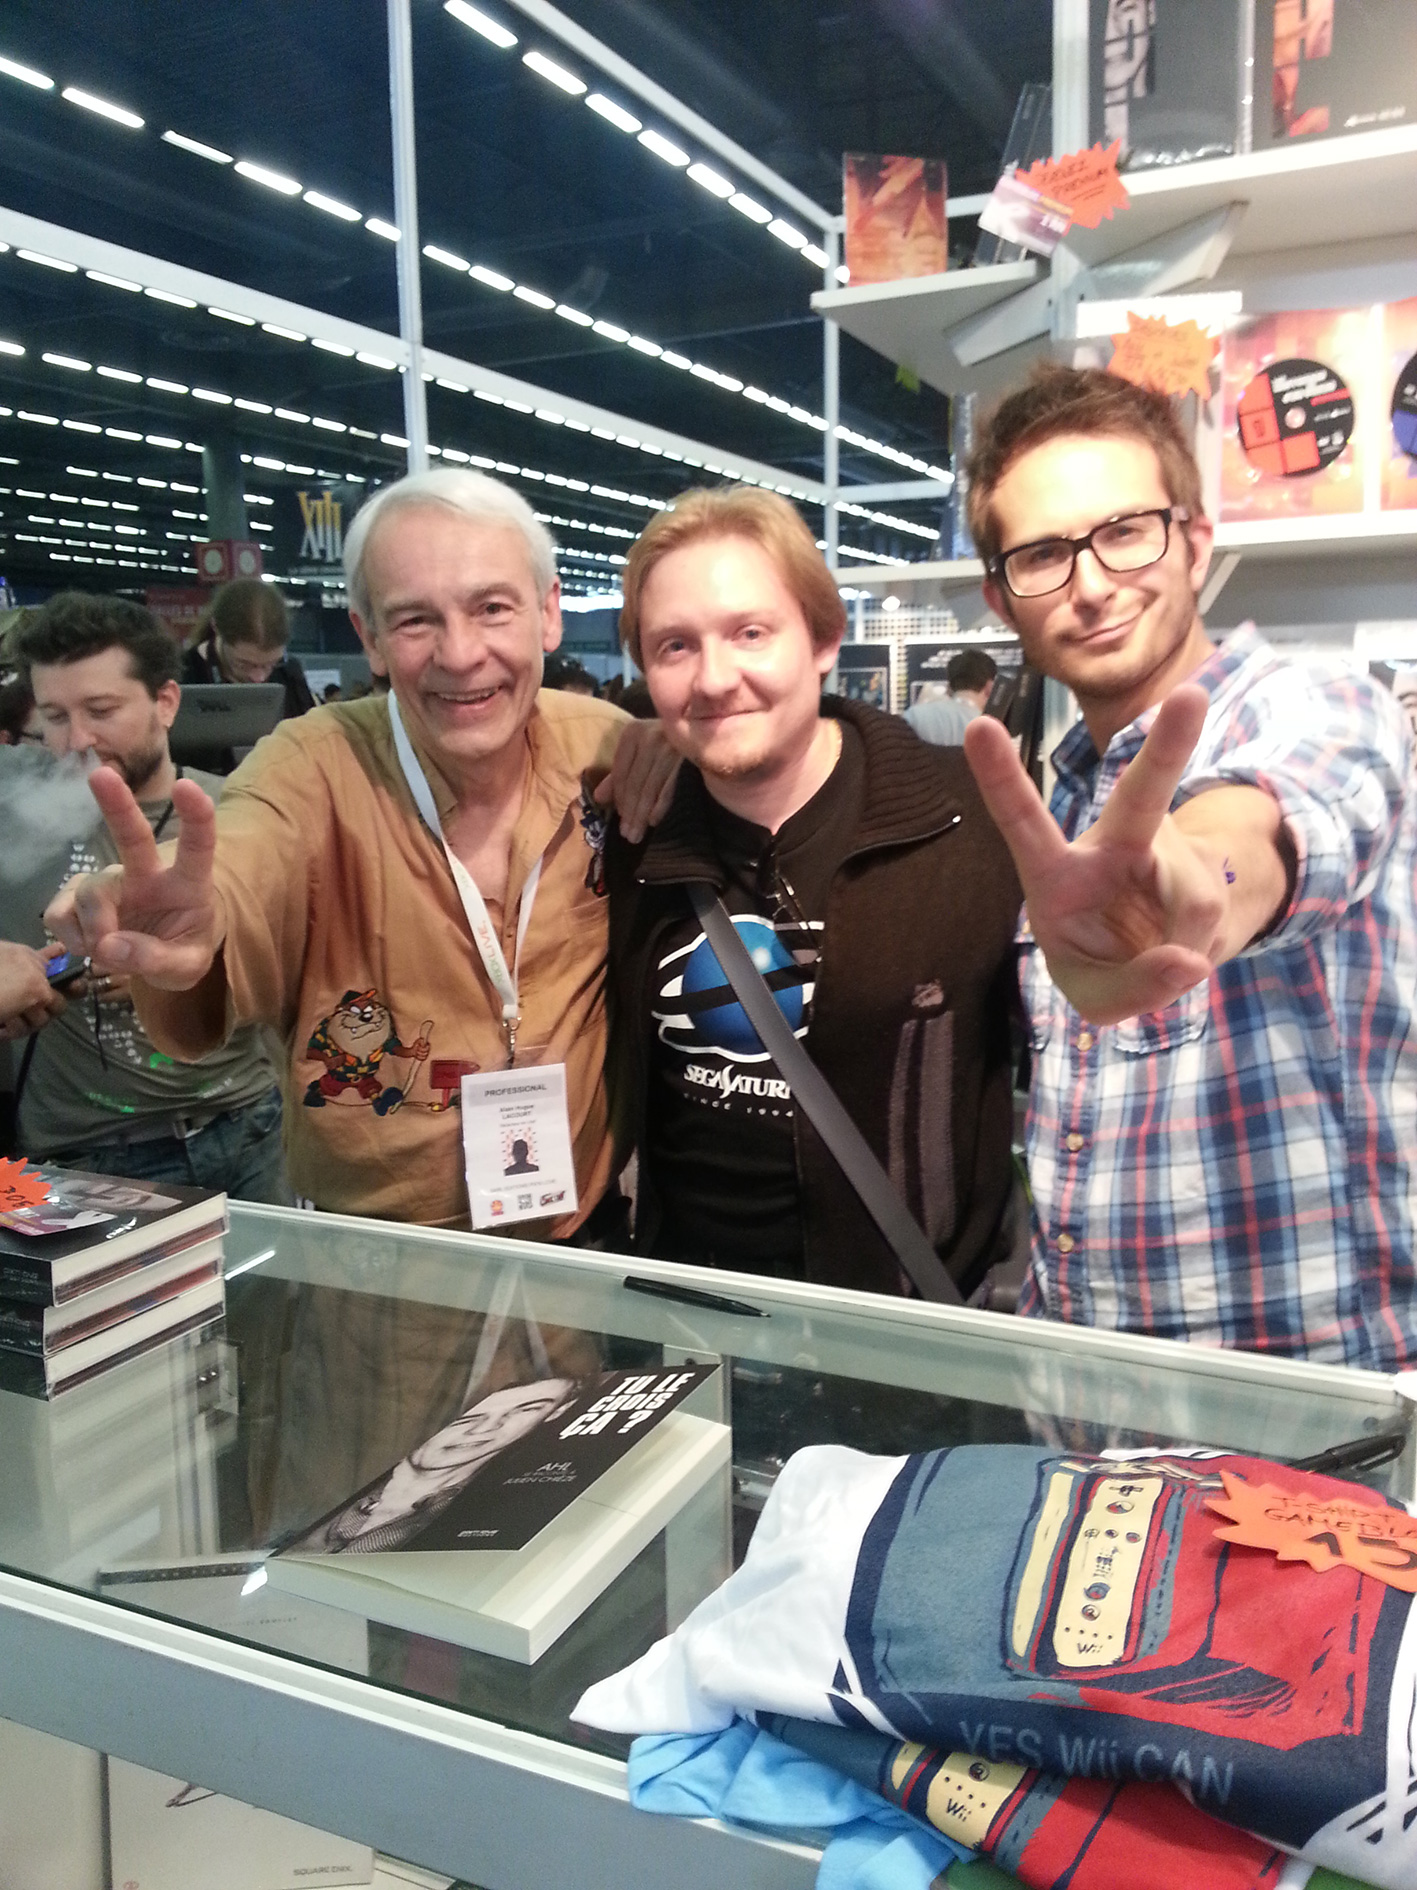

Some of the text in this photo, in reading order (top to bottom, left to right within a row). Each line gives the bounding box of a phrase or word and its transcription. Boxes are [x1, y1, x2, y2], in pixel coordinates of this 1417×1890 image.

[485, 1084, 547, 1097] PROFESSIONAL
[610, 1372, 696, 1396] TU LE
[587, 1392, 674, 1413] CROIS
[558, 1410, 654, 1440] ÇA ?
[1077, 1642, 1103, 1654] Wii
[958, 1720, 1235, 1803] YES Wii CAN
[945, 1798, 971, 1822] Wii
